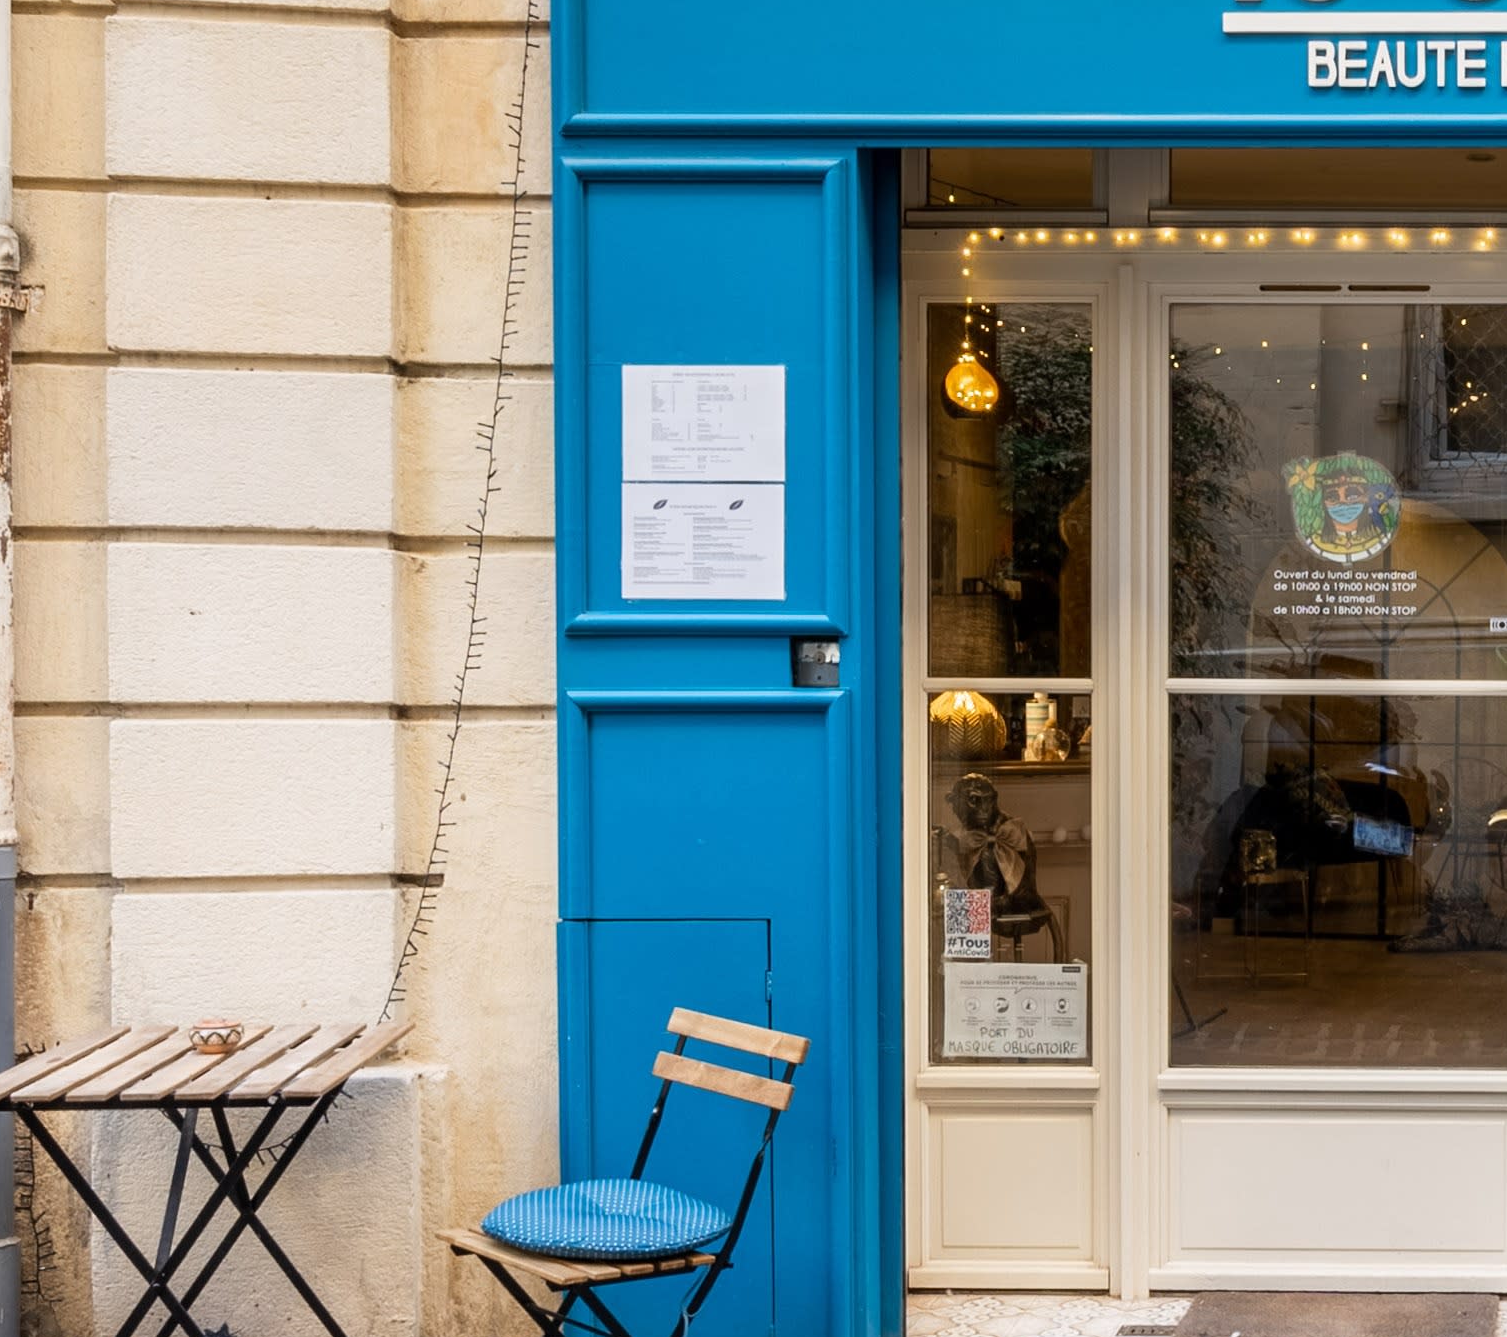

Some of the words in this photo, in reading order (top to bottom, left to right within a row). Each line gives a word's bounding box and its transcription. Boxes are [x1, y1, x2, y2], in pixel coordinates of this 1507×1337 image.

[1307, 40, 1487, 89] BEAUTE
[1274, 569, 1309, 580] Ouvert
[1311, 569, 1325, 580] du
[1327, 569, 1353, 580] lundi
[1355, 572, 1369, 580] au
[1371, 569, 1418, 580] vendredi
[1273, 582, 1288, 591] de
[1291, 582, 1320, 591] 10h00
[1334, 582, 1363, 591] 19h00
[1365, 582, 1389, 591] NON
[1392, 582, 1418, 592] STOP
[1315, 594, 1323, 603] &
[1326, 594, 1336, 603] le
[1338, 594, 1376, 603] samedi
[1273, 606, 1288, 615] de
[1291, 606, 1320, 615] 10h00
[1334, 606, 1363, 615] 18h00
[1365, 606, 1389, 615] NON
[1392, 606, 1418, 616] STOP
[947, 936, 990, 948] #Tous
[947, 948, 990, 957] AntiCovid
[980, 1027, 1008, 1038] PORT
[1016, 1027, 1034, 1039] DU
[948, 1041, 995, 1054] MASQUE
[1003, 1041, 1079, 1055] OBLIGATOIRE
